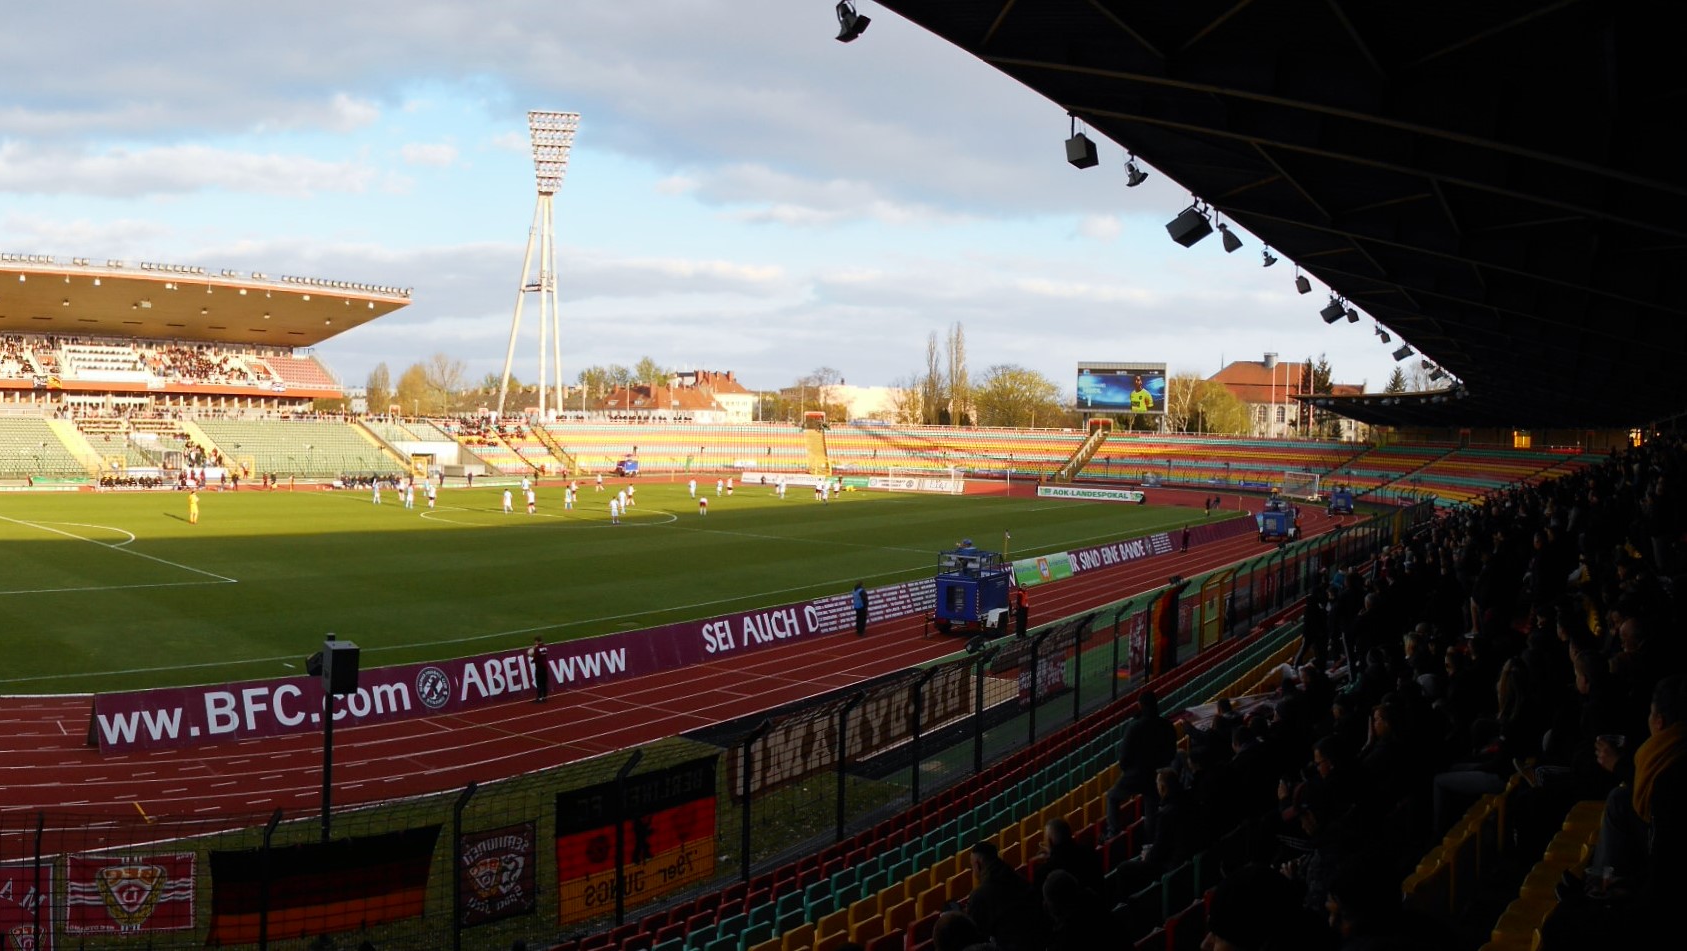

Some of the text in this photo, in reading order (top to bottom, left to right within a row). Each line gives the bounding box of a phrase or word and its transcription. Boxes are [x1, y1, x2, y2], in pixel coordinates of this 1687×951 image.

[1052, 488, 1129, 499] AOK-LANDESPOKAL
[1080, 549, 1101, 570] SIND
[1100, 545, 1121, 565] EINE
[1119, 540, 1146, 561] BANDE
[702, 619, 736, 654] SEI
[741, 610, 802, 648] AUCH
